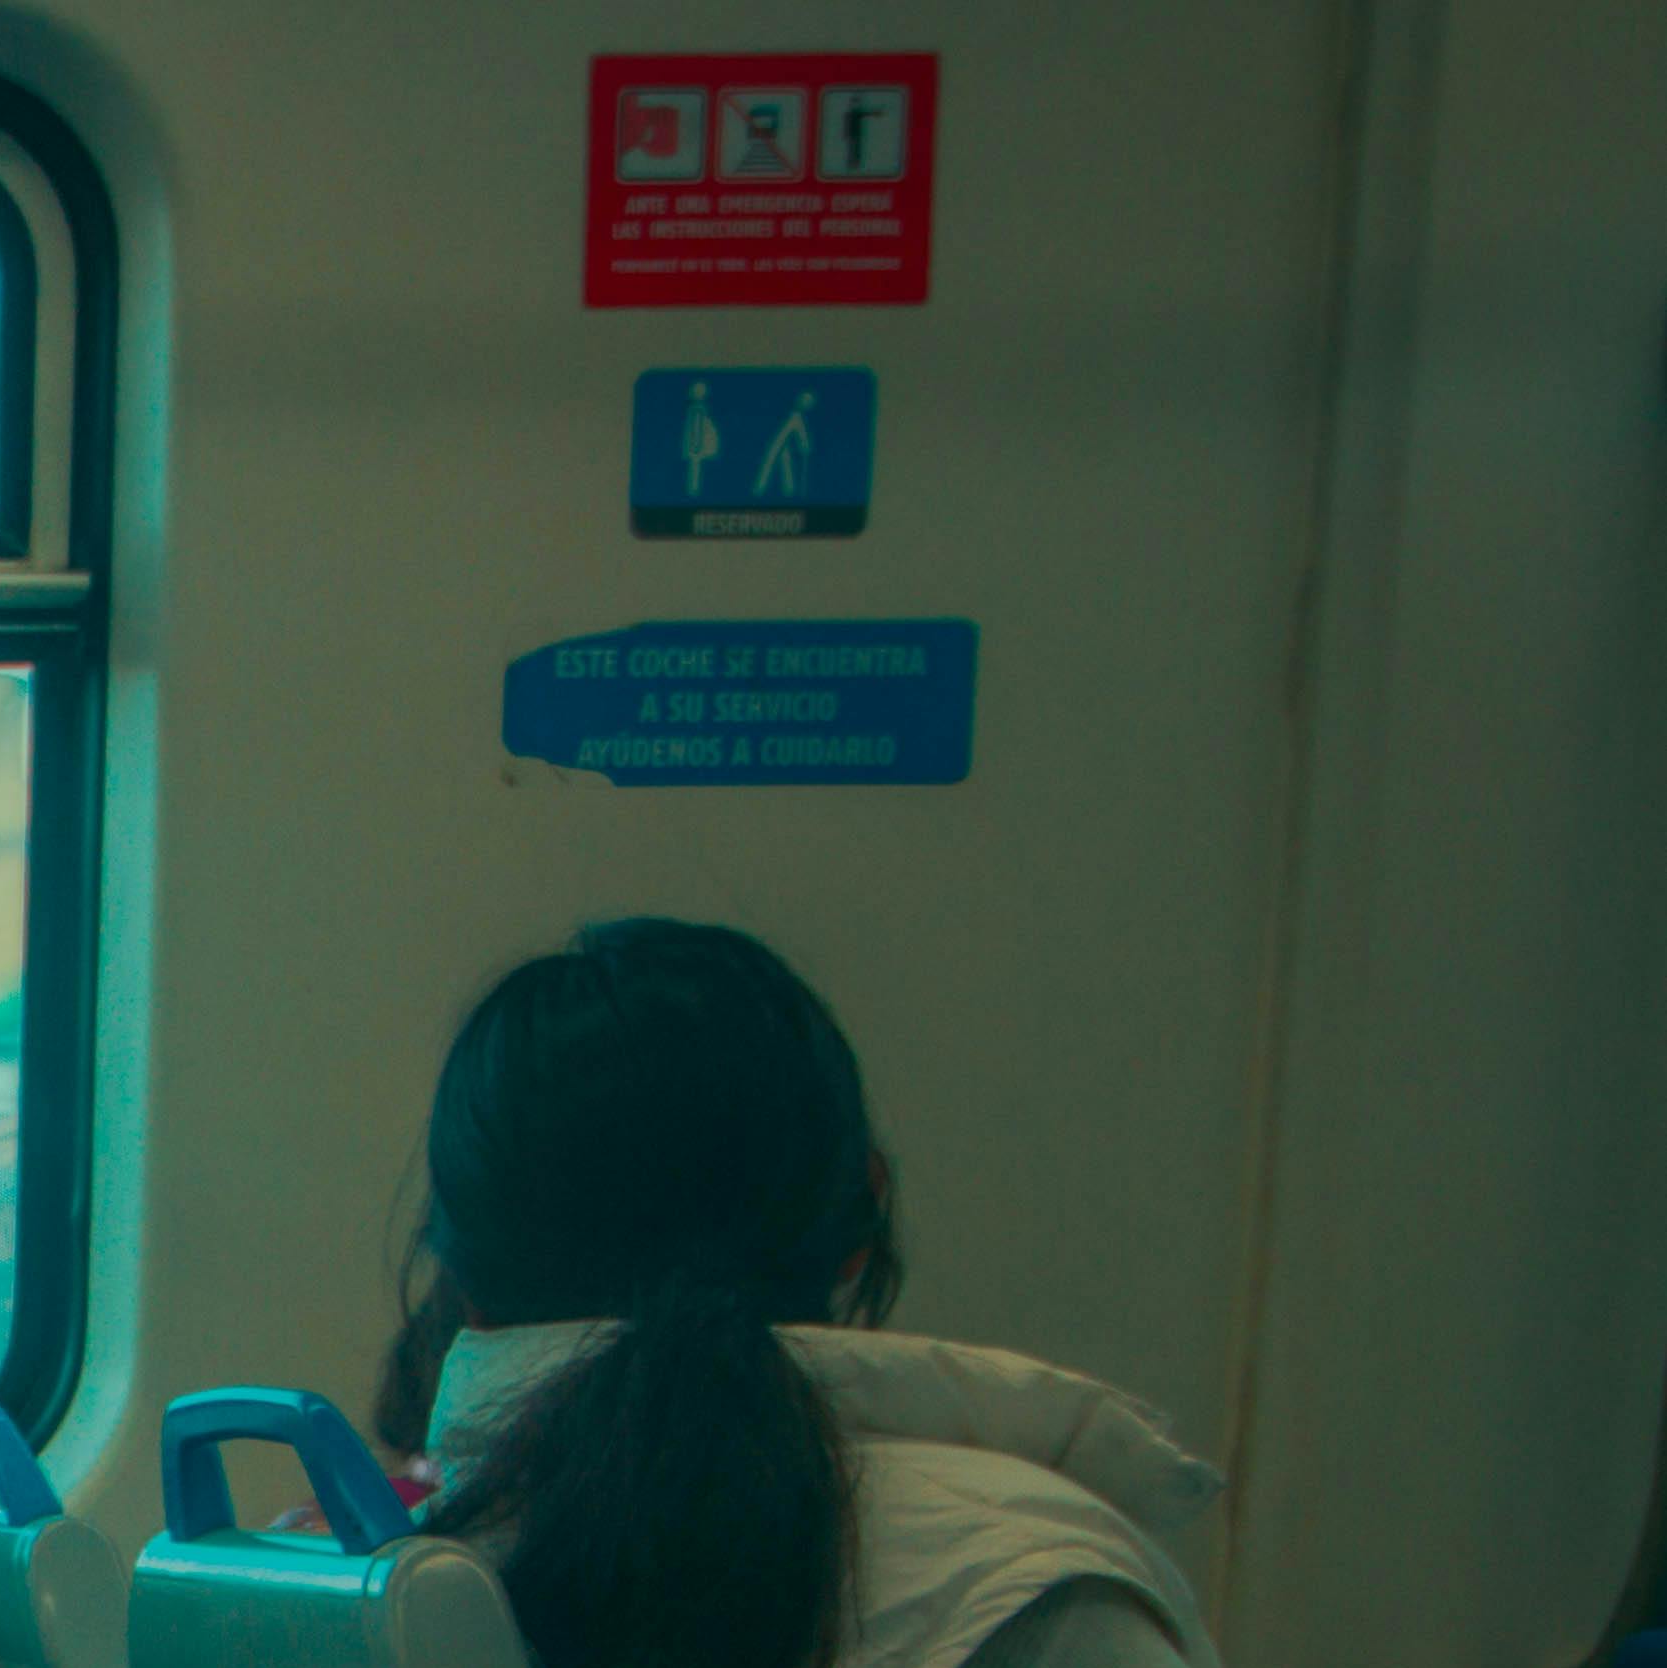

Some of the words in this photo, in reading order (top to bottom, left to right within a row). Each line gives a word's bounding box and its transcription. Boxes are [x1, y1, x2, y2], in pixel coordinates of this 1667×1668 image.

[611, 219, 642, 241] LAS
[555, 648, 619, 679] ESTE
[628, 646, 715, 679] COCHE
[723, 646, 756, 678] SE
[766, 646, 926, 677] ENCUENTRA
[638, 691, 662, 724] A
[667, 690, 706, 724] SU
[712, 690, 838, 723] SERVICIO
[731, 736, 752, 766] A
[760, 736, 896, 767] CUIDARLO
